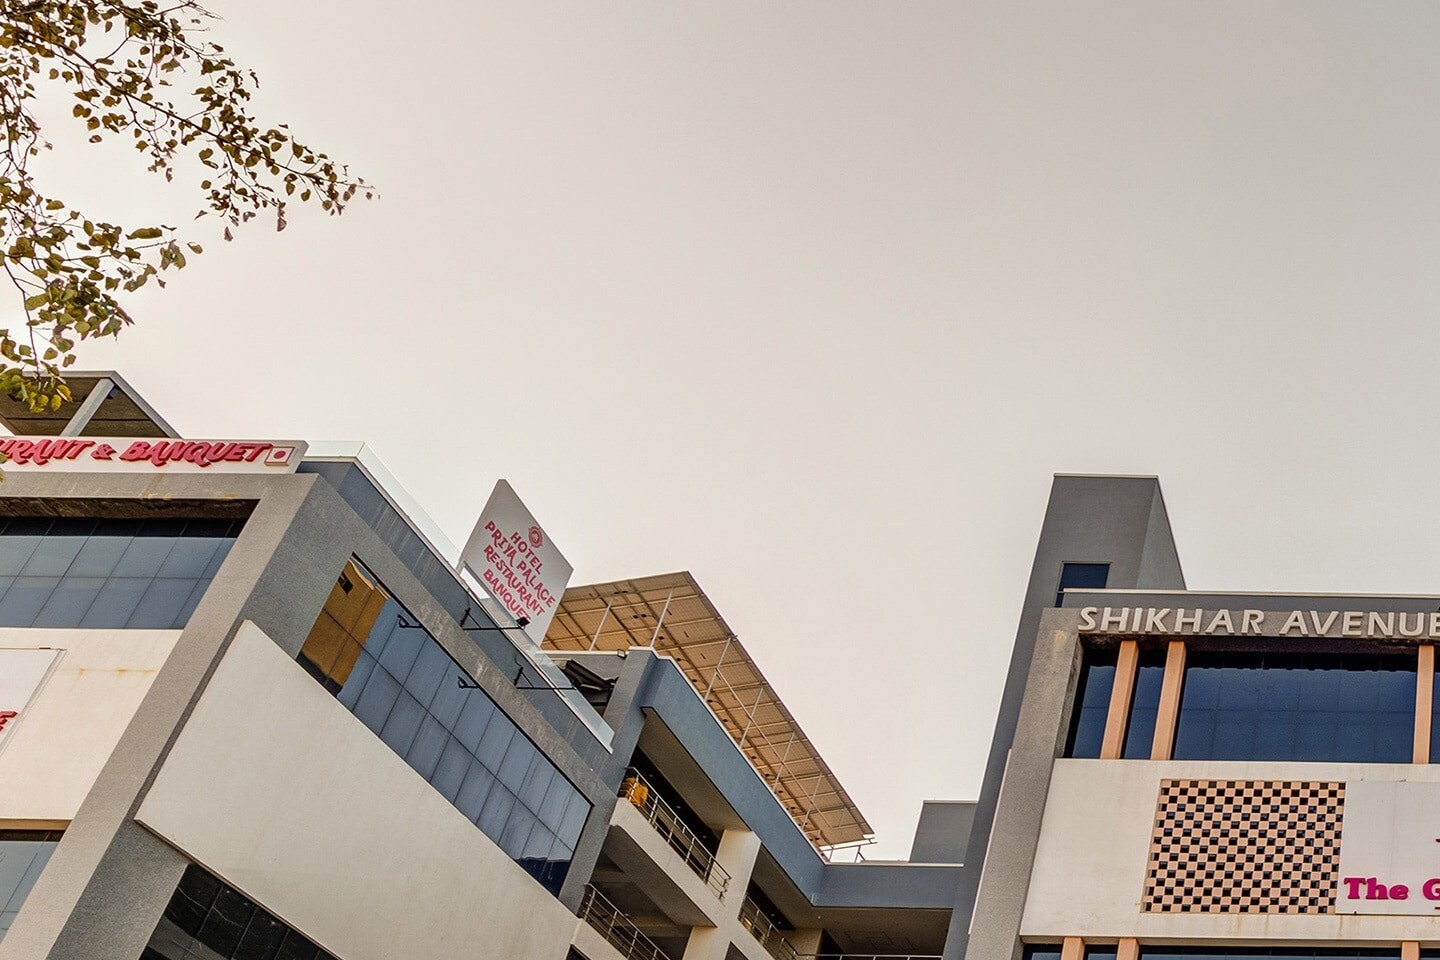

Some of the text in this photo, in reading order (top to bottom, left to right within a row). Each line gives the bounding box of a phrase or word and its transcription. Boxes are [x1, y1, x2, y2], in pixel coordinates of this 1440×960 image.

[92, 442, 118, 461] &
[119, 440, 274, 468] BANQUET
[484, 520, 556, 608] PRIYA PALACE
[510, 532, 544, 575] HOTEL
[483, 545, 546, 617] RESTAURANT
[1077, 605, 1265, 635] SHIKHAR
[1343, 877, 1409, 900] The
